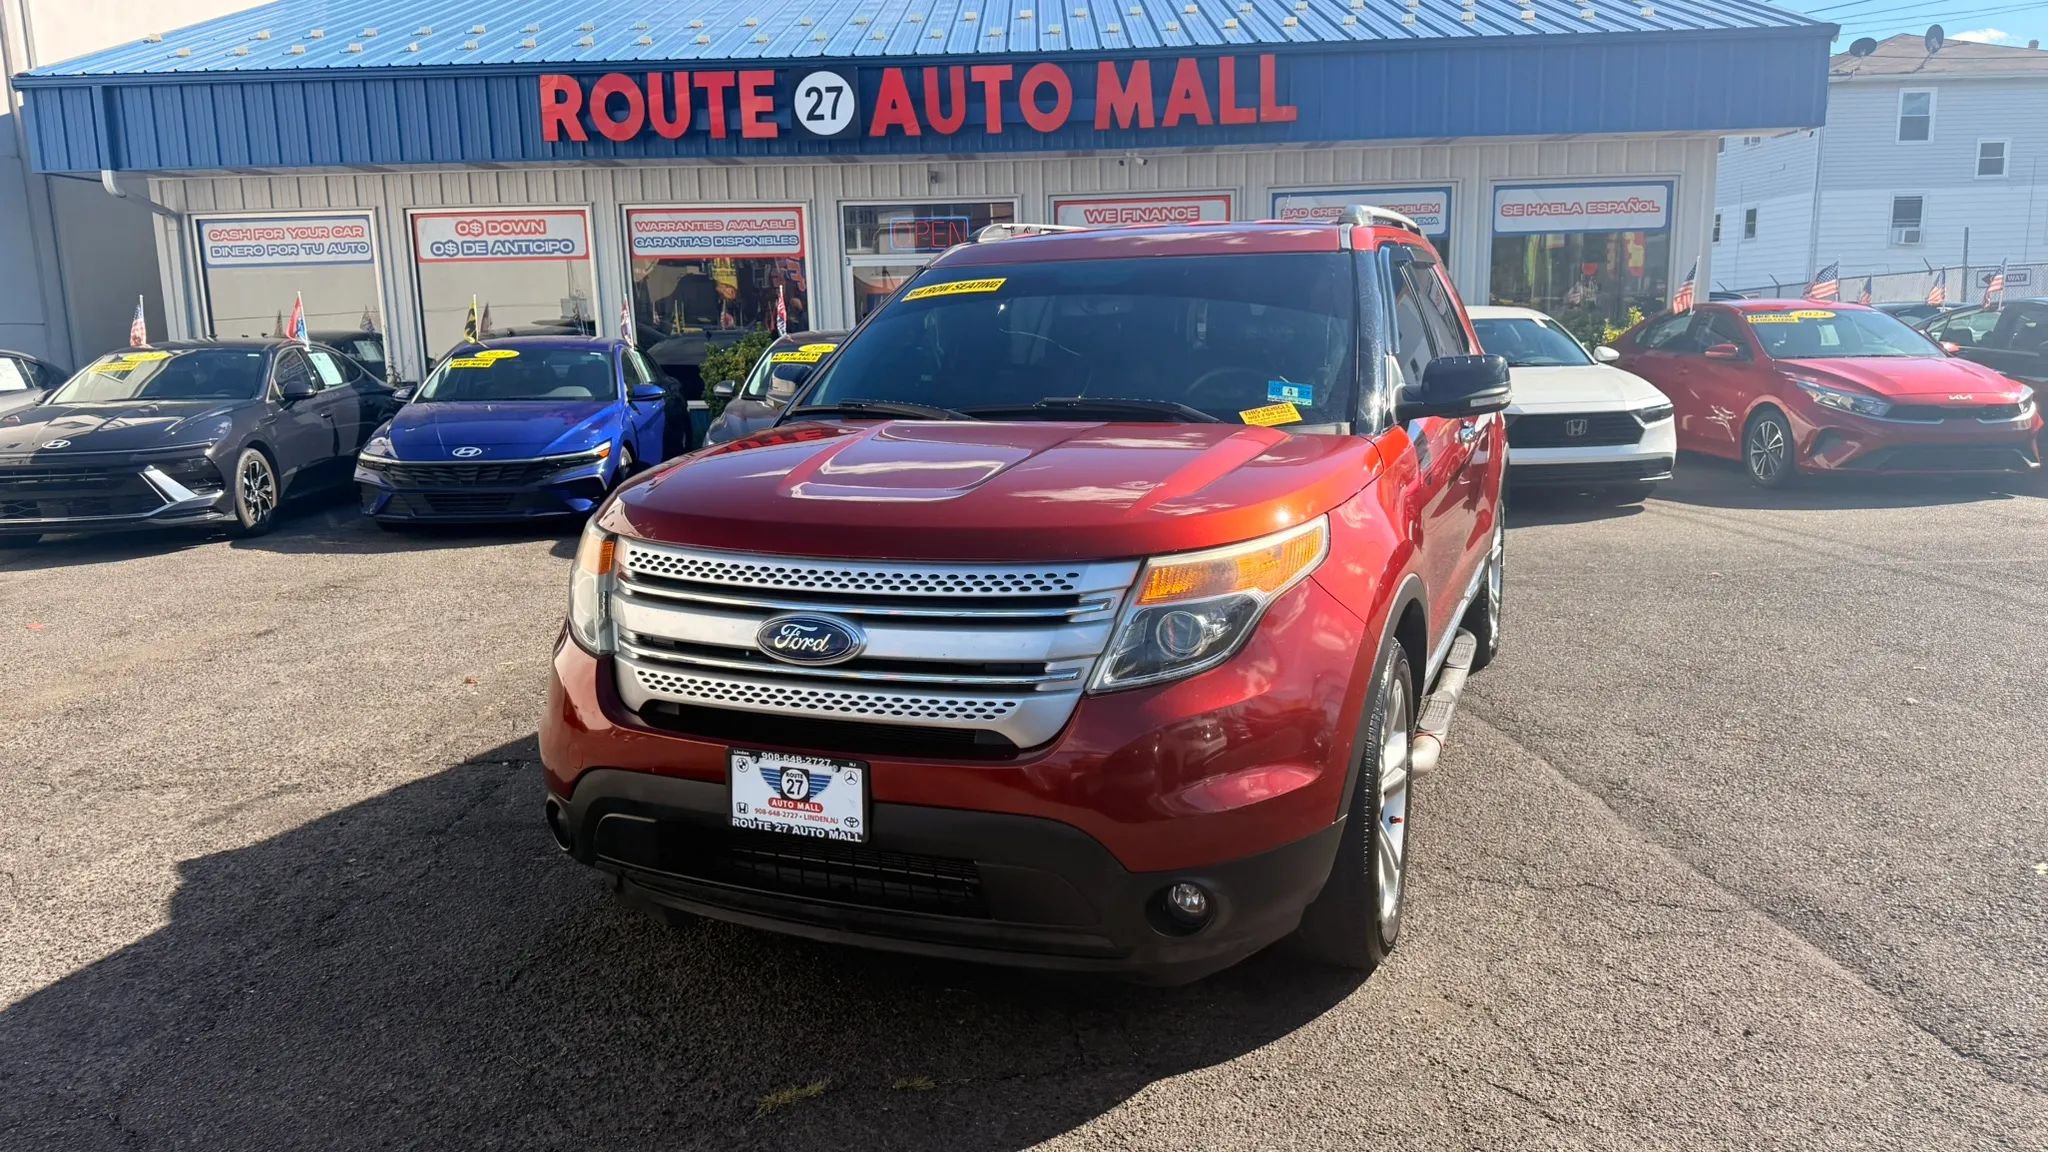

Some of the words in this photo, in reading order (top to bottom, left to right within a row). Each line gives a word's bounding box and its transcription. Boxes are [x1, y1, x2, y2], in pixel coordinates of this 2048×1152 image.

[539, 69, 779, 142] ROUTE
[804, 85, 844, 121] 27
[868, 62, 1073, 137] AUTO
[1094, 54, 1297, 130] MALL
[1281, 207, 1309, 219] BAD
[1310, 206, 1346, 218] CRED
[1501, 203, 1525, 217] SE
[1526, 202, 1583, 217] HABLA
[1585, 196, 1660, 214] ESPAÑOL
[1084, 208, 1118, 224] WE
[1119, 206, 1200, 223] FINANCE
[209, 228, 251, 242] CASH
[254, 228, 285, 241] FOR
[287, 226, 330, 240] YOUR
[331, 225, 364, 238] CAR
[485, 219, 546, 236] DOWN
[635, 219, 723, 233] WARRANTIES
[726, 219, 796, 232] AVAILABLE
[893, 220, 966, 248] OPEN
[461, 240, 488, 255] DE
[490, 238, 574, 254] ANTICIPO
[634, 235, 711, 248] GARANTIAS
[712, 234, 799, 247] DISPONIBLES
[211, 244, 265, 258] DINERO
[267, 243, 299, 256] POR
[301, 242, 324, 255] TU
[327, 242, 369, 254] AUTO
[2007, 273, 2025, 281] WAY
[925, 284, 953, 294] ROW
[953, 280, 1002, 290] SEATING
[774, 623, 832, 652] Ford
[761, 752, 832, 767] 908-648-2727
[786, 772, 804, 780] ROUTE
[786, 778, 804, 796] 27
[754, 807, 798, 818] 908-648-2727
[771, 799, 794, 809] AUTO
[797, 801, 820, 812] MALL
[732, 817, 772, 831] ROUTE
[774, 823, 788, 833] 27
[792, 826, 825, 838] AUTO
[828, 829, 862, 842] MALL
